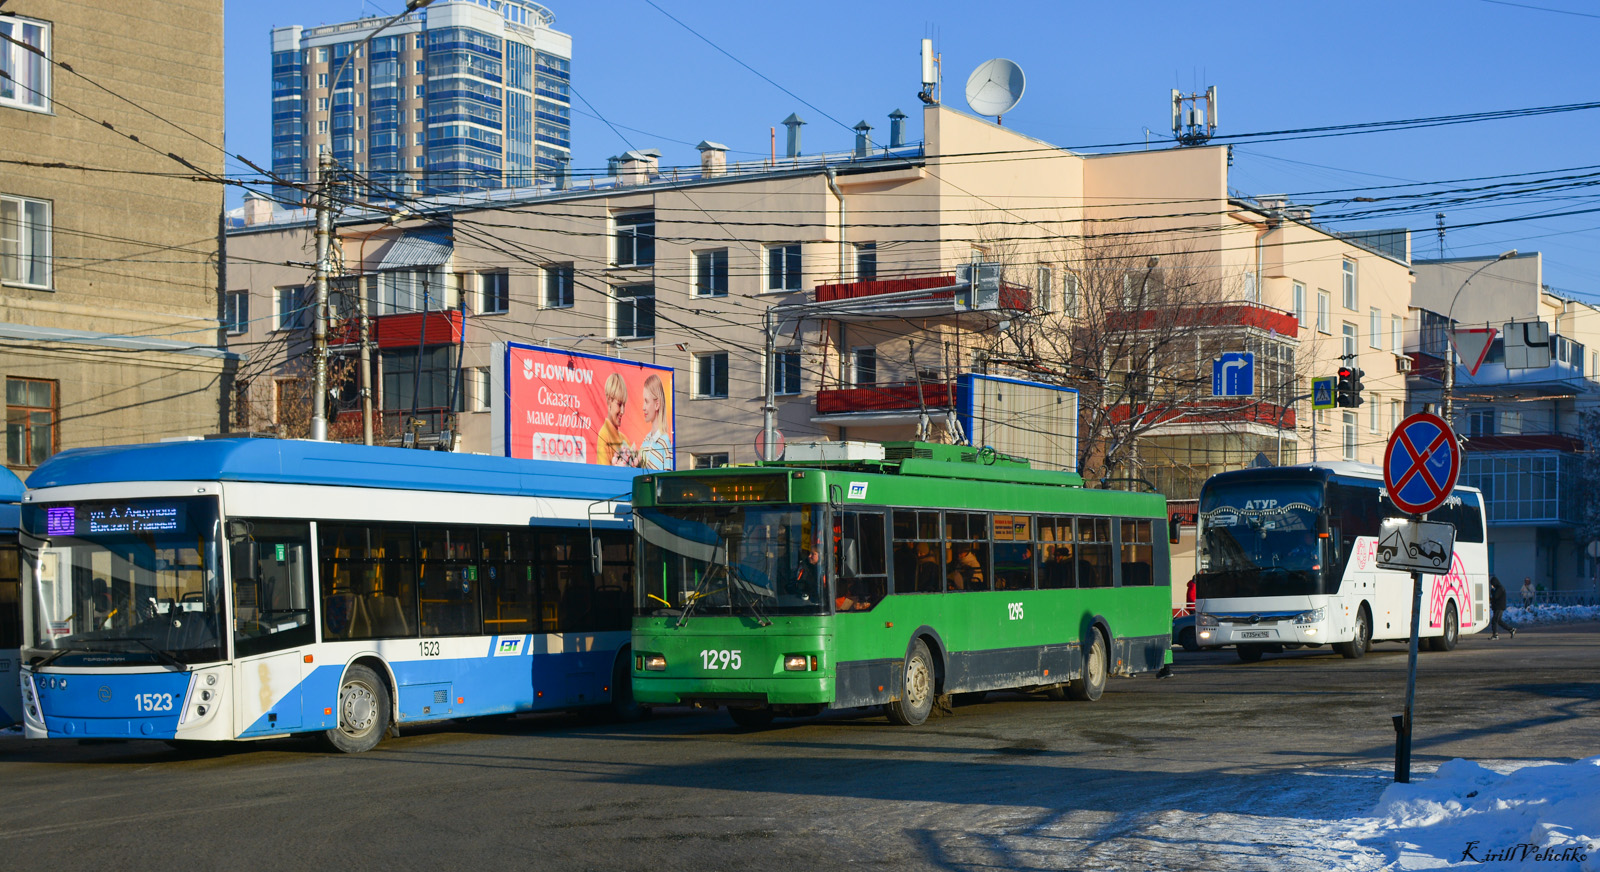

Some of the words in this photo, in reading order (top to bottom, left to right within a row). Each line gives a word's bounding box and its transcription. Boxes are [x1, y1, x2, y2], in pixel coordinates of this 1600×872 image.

[534, 362, 594, 385] FLOWWOW
[537, 385, 581, 409] Сказать
[526, 409, 554, 425] маме
[555, 410, 592, 430] люблю
[1245, 499, 1278, 509] АТУР
[132, 518, 177, 531] Главный
[1007, 602, 1024, 620] 1295
[419, 641, 440, 656] 1523
[700, 649, 742, 671] 1295
[134, 693, 173, 711] 1523
